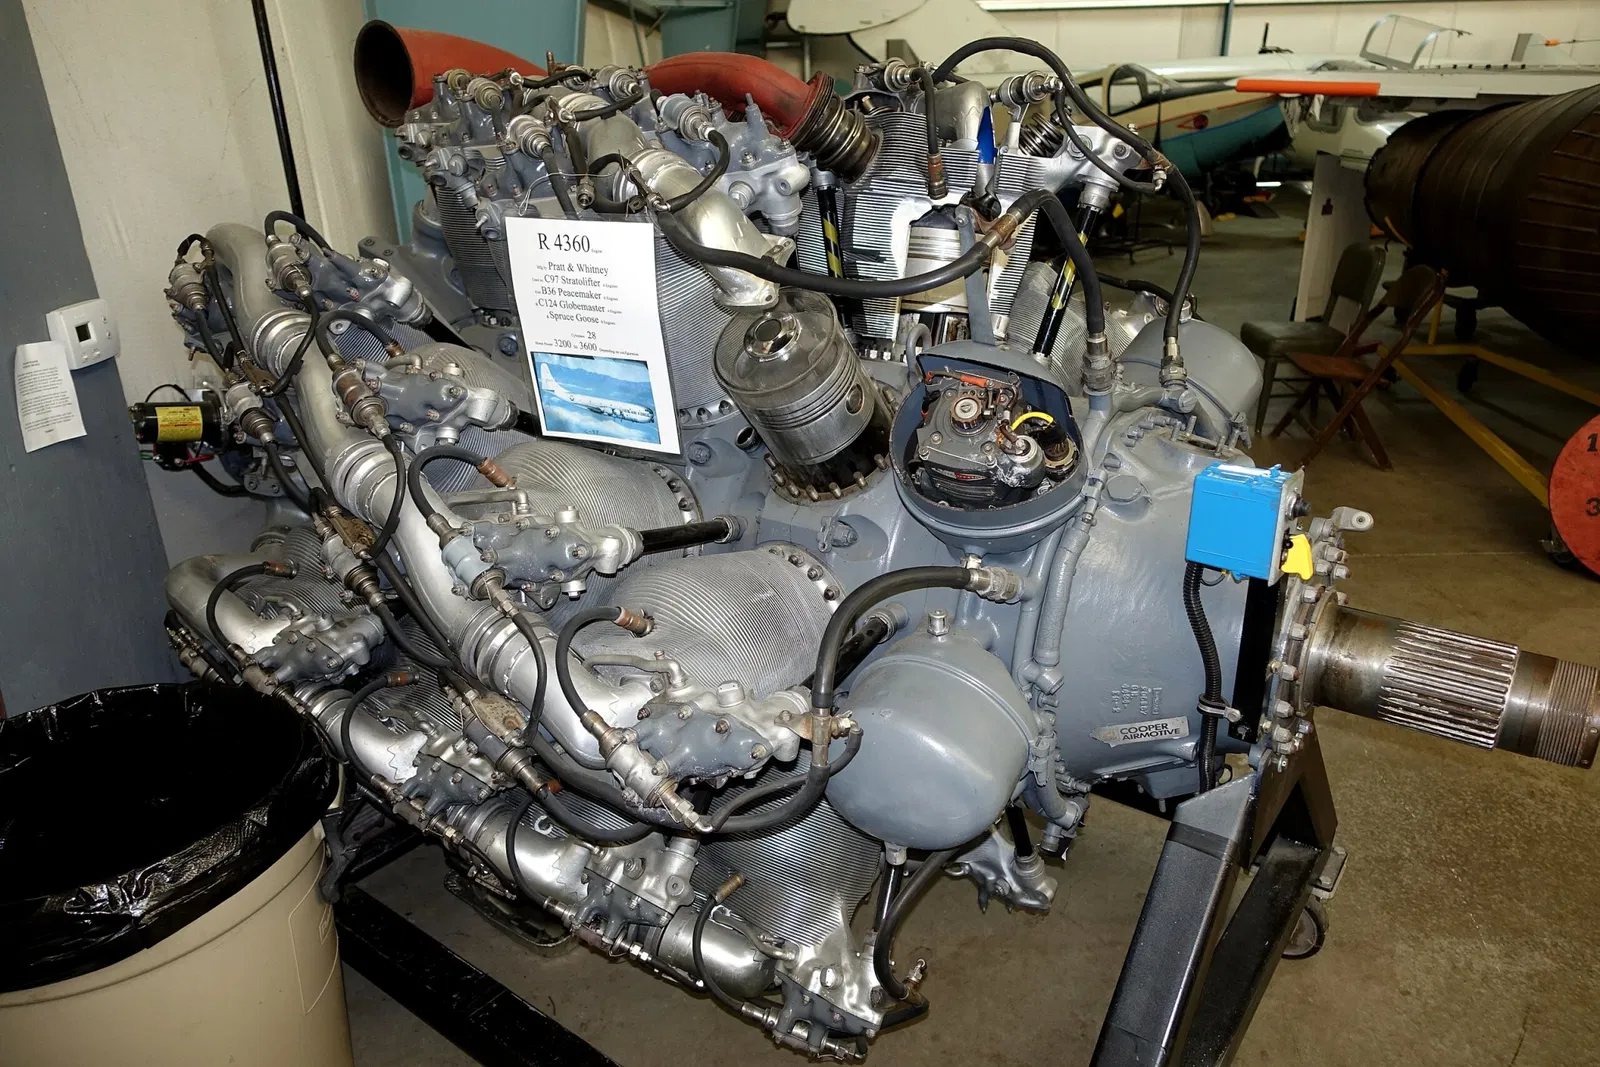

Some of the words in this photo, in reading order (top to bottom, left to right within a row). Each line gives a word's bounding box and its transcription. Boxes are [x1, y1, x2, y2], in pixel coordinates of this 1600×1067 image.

[537, 232, 550, 250] R
[553, 233, 591, 253] 4360
[548, 261, 566, 272] Pratt
[567, 262, 575, 272] &
[576, 262, 609, 277] Whitney
[544, 274, 559, 284] C97
[560, 275, 601, 288] Stratolifter
[541, 286, 557, 296] B36
[557, 287, 602, 300] Peacemaker
[538, 298, 558, 308] C124
[559, 299, 606, 313] Globemaster
[549, 310, 574, 322] Spruce
[575, 313, 600, 324] Goose
[586, 330, 597, 340] 28
[553, 338, 572, 349] 3200
[579, 341, 598, 352] 3600
[1587, 433, 1599, 453] 1
[1120, 722, 1169, 735] COOPER
[1122, 727, 1181, 741] AIRMOTIVE
